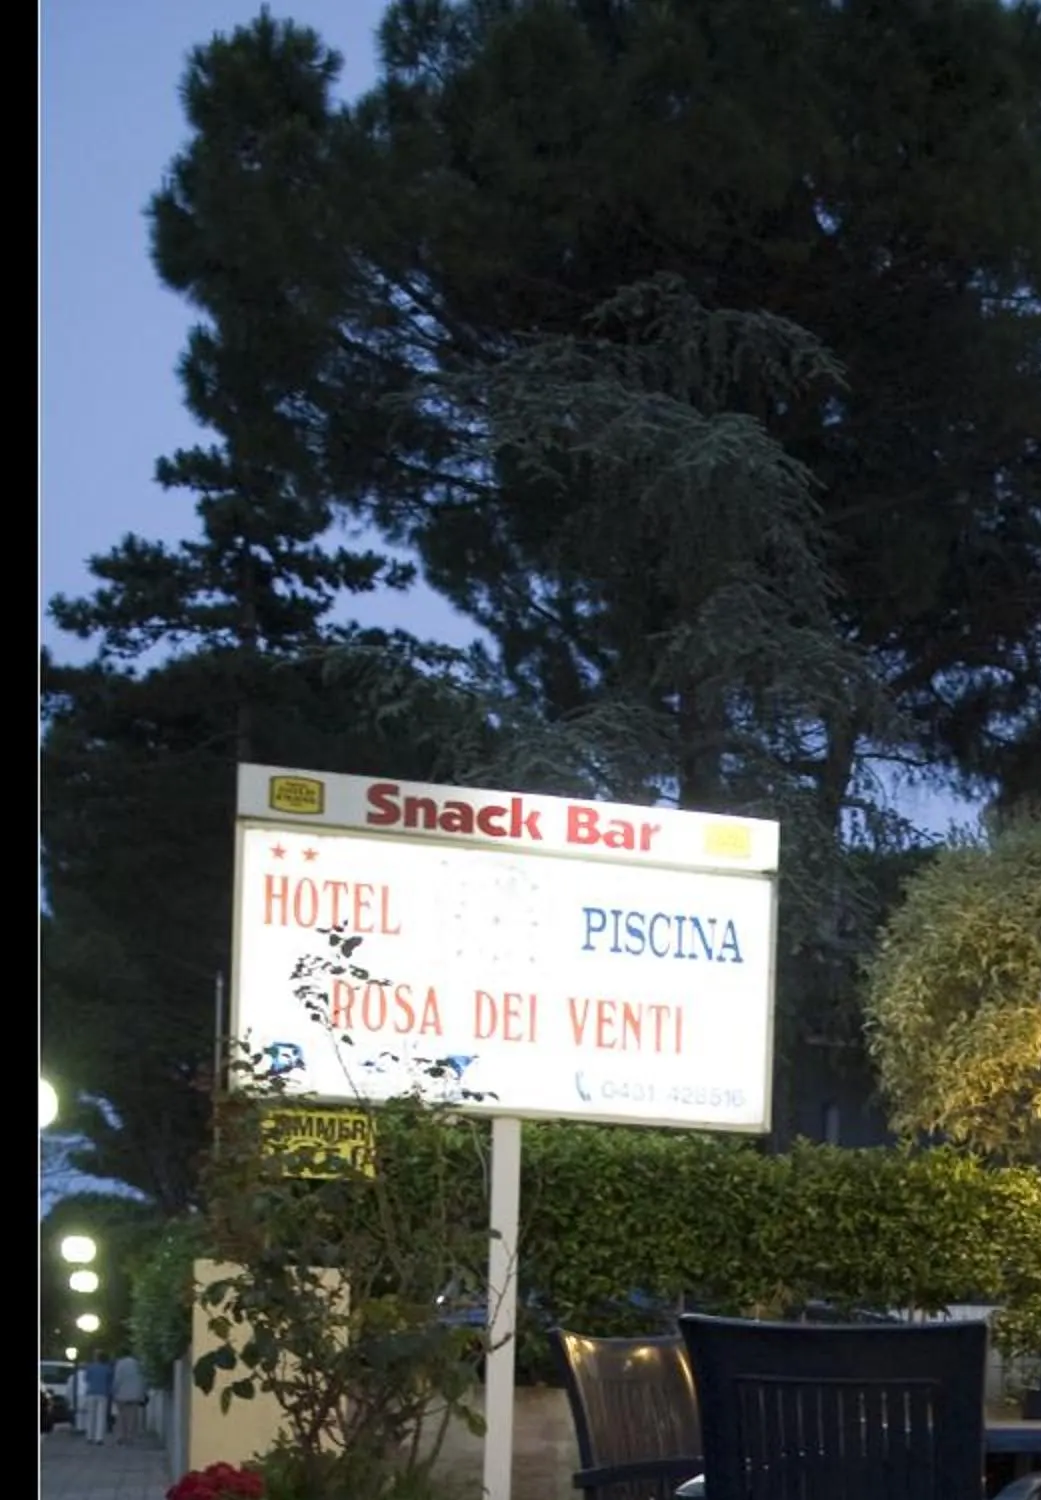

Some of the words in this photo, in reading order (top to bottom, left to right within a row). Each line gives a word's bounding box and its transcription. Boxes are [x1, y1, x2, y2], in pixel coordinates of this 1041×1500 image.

[366, 783, 543, 841] Snack
[566, 805, 661, 852] Bar
[264, 874, 402, 935] HOTEL
[581, 906, 744, 963] PISCINA
[331, 979, 443, 1036] ROSA
[473, 990, 538, 1042] DEI
[568, 997, 684, 1055] VENTI
